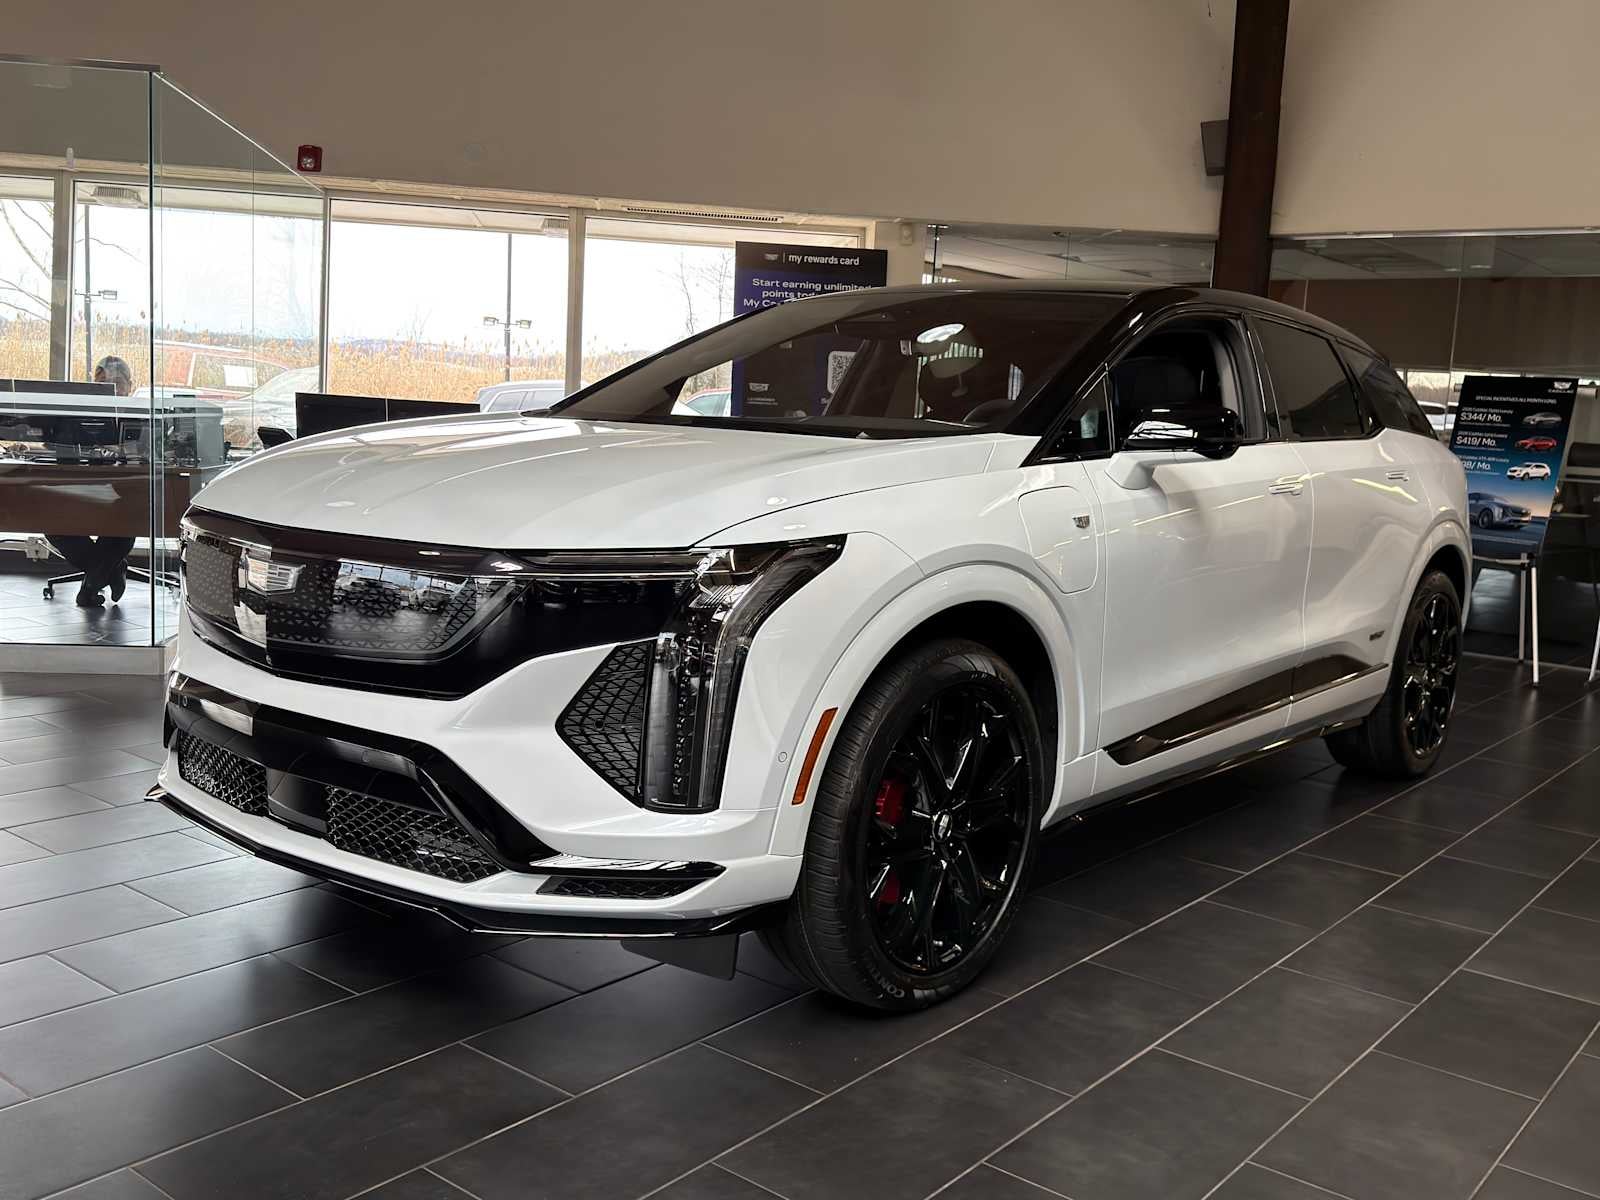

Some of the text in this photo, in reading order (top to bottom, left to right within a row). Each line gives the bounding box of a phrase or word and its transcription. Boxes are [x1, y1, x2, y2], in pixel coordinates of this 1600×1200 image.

[788, 254, 860, 266] my rewards card
[752, 278, 781, 288] Start
[782, 281, 822, 291] earning
[762, 289, 794, 299] points
[743, 298, 760, 308] My
[1487, 413, 1502, 423] Mo.
[1481, 437, 1497, 447] Mo.
